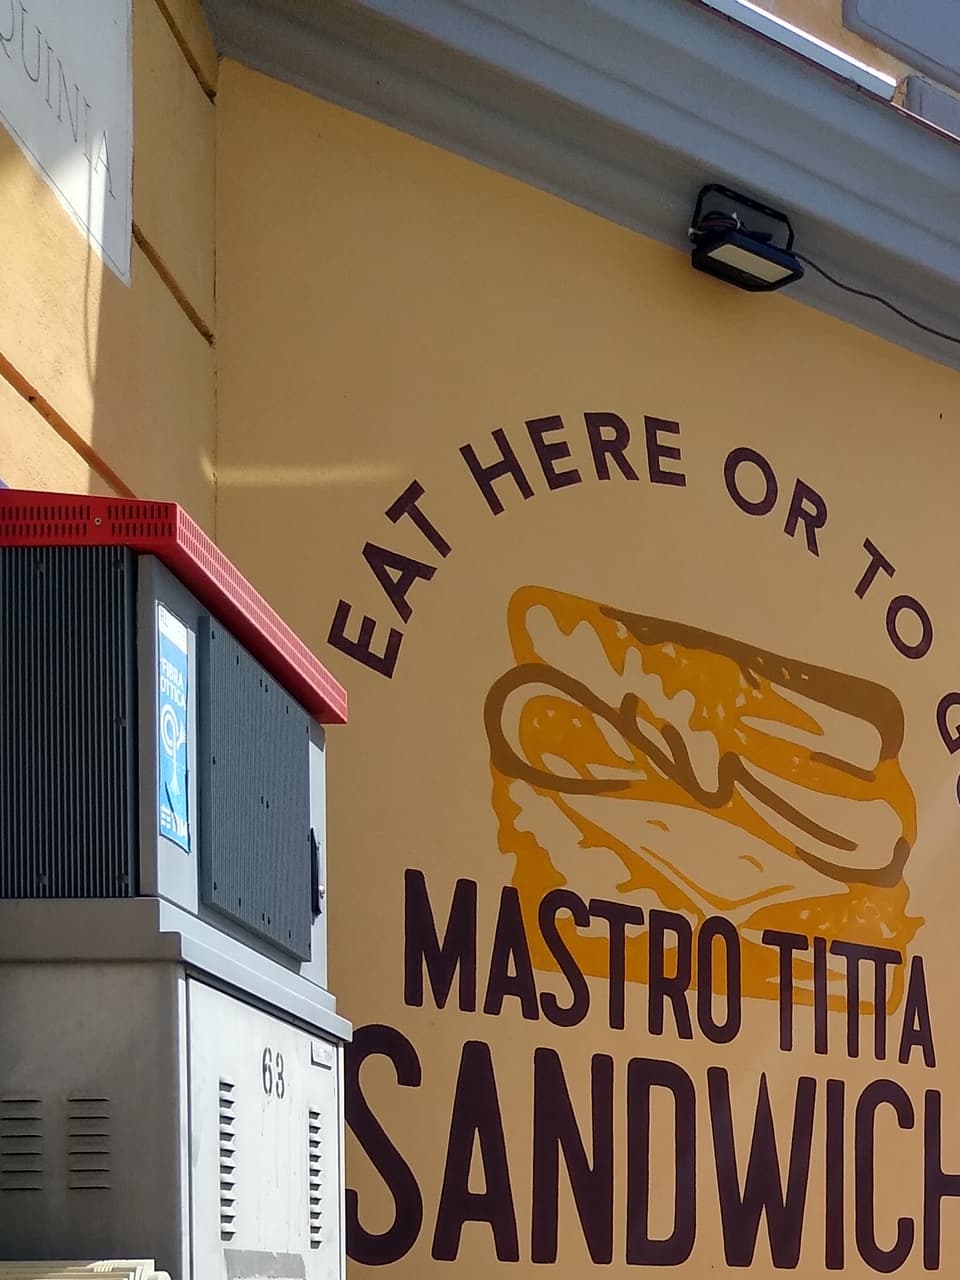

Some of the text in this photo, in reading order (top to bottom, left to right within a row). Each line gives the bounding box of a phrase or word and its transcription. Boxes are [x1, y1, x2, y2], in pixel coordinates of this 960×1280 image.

[327, 480, 452, 679] EAT
[459, 412, 686, 516] HERE
[723, 447, 828, 557] OR
[854, 538, 934, 660] TO
[404, 868, 936, 1068] MASTRO TITTA
[263, 1047, 284, 1099] 63
